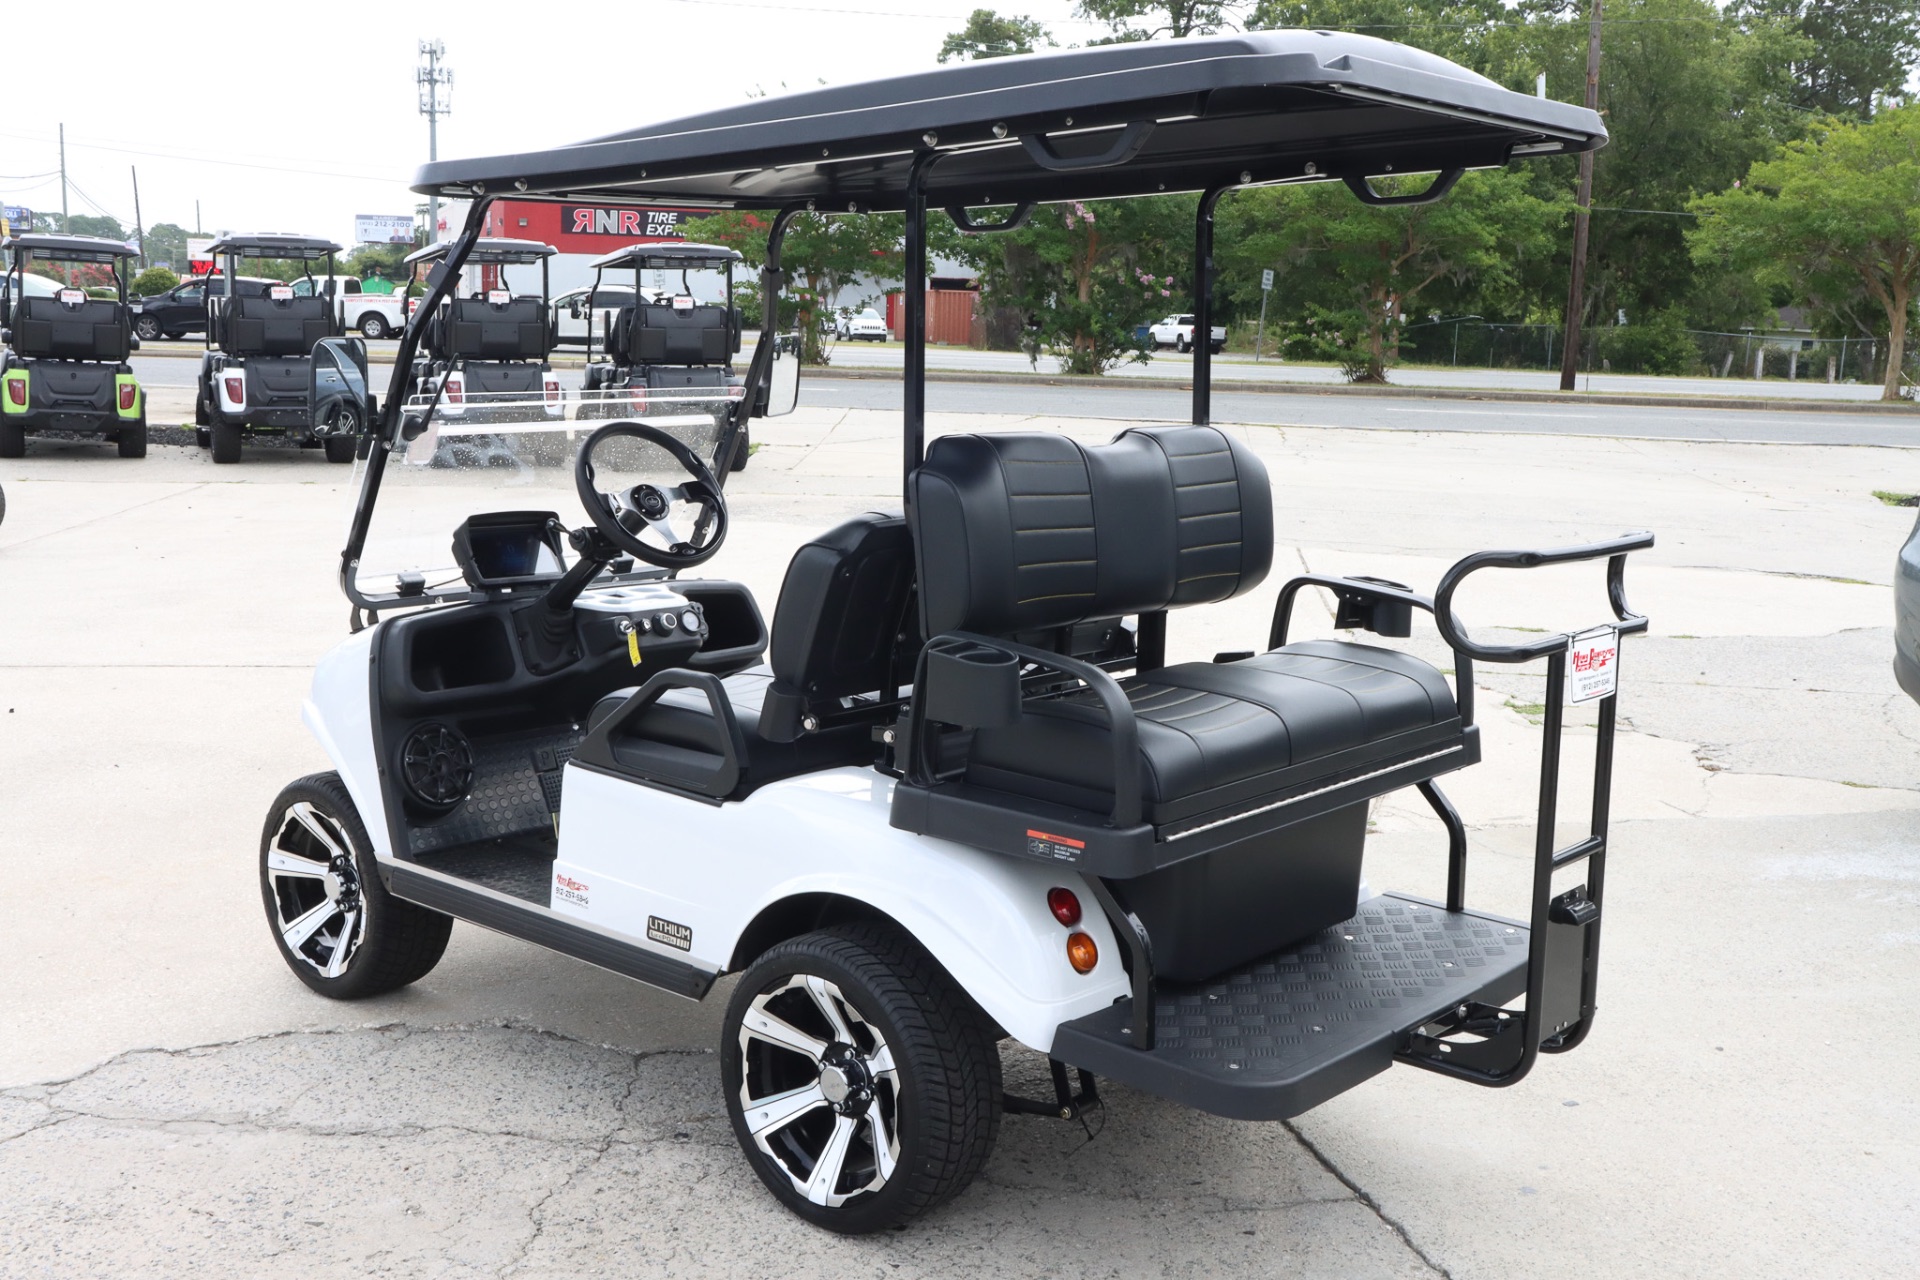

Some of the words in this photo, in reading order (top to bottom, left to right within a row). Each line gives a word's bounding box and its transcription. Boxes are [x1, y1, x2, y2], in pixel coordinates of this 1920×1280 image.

[572, 208, 641, 235] RNR
[647, 211, 678, 224] TIRE
[1048, 835, 1068, 844] WARNING
[649, 917, 691, 940] LITHIUM
